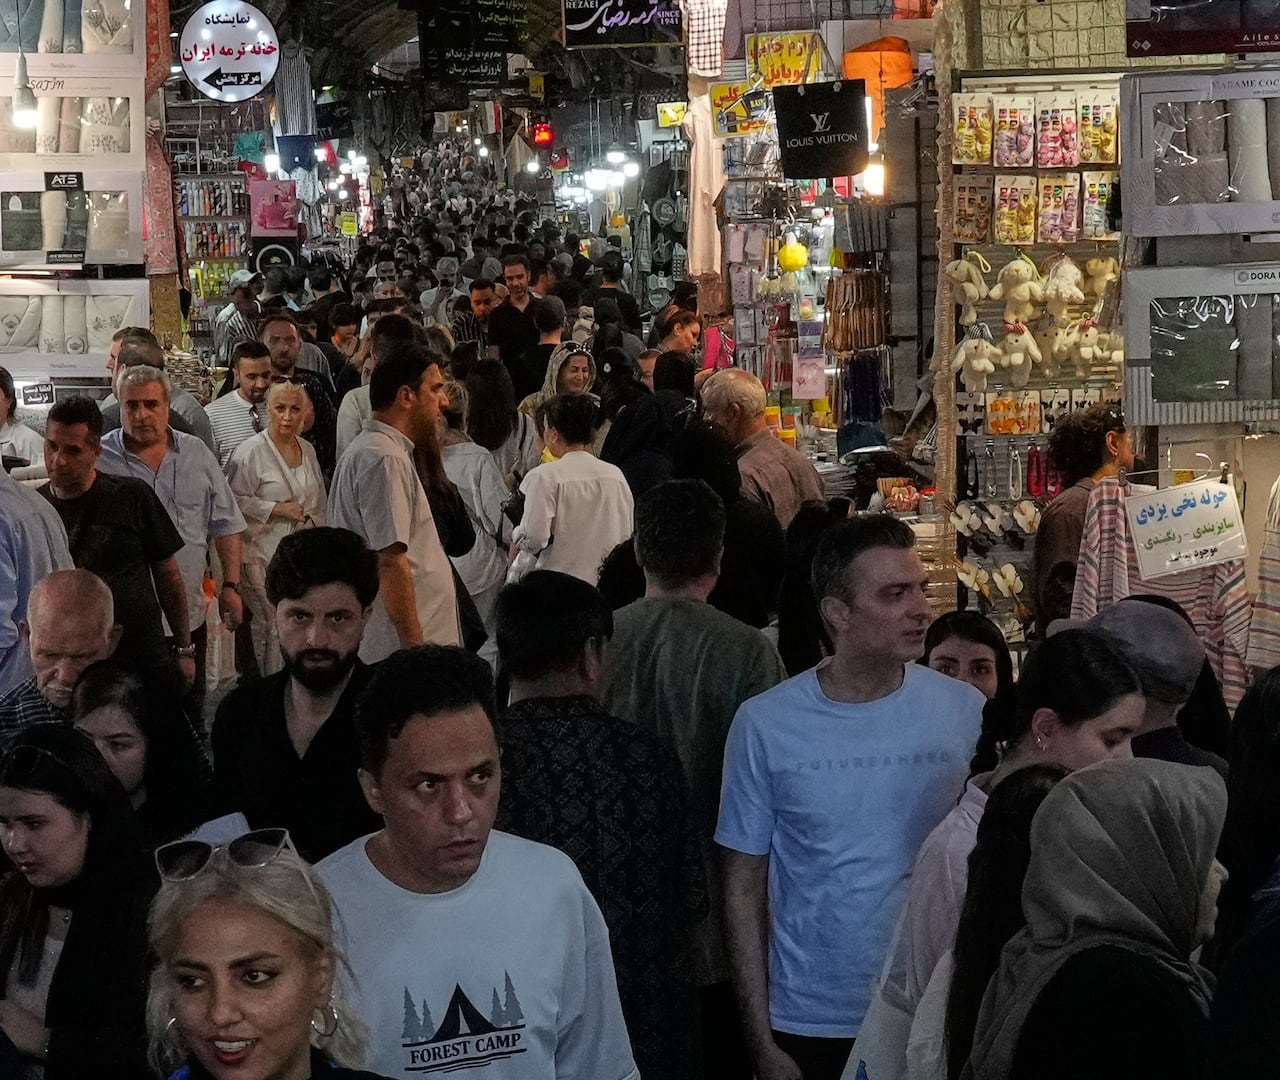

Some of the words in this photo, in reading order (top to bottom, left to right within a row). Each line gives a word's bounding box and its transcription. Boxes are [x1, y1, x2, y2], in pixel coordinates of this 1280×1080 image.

[657, 10, 680, 18] SINCE
[182, 42, 215, 62] ایران
[786, 136, 814, 148] LOUIS
[816, 133, 858, 144] VUITTON
[51, 174, 77, 185] ATS
[1250, 269, 1277, 281] DORA
[1171, 493, 1197, 517] نخی
[1201, 488, 1228, 509] حوله
[1137, 503, 1168, 525] یزدی
[1194, 546, 1218, 559] موجود
[410, 1040, 471, 1064] FOREST
[475, 1033, 521, 1052] CAMP
